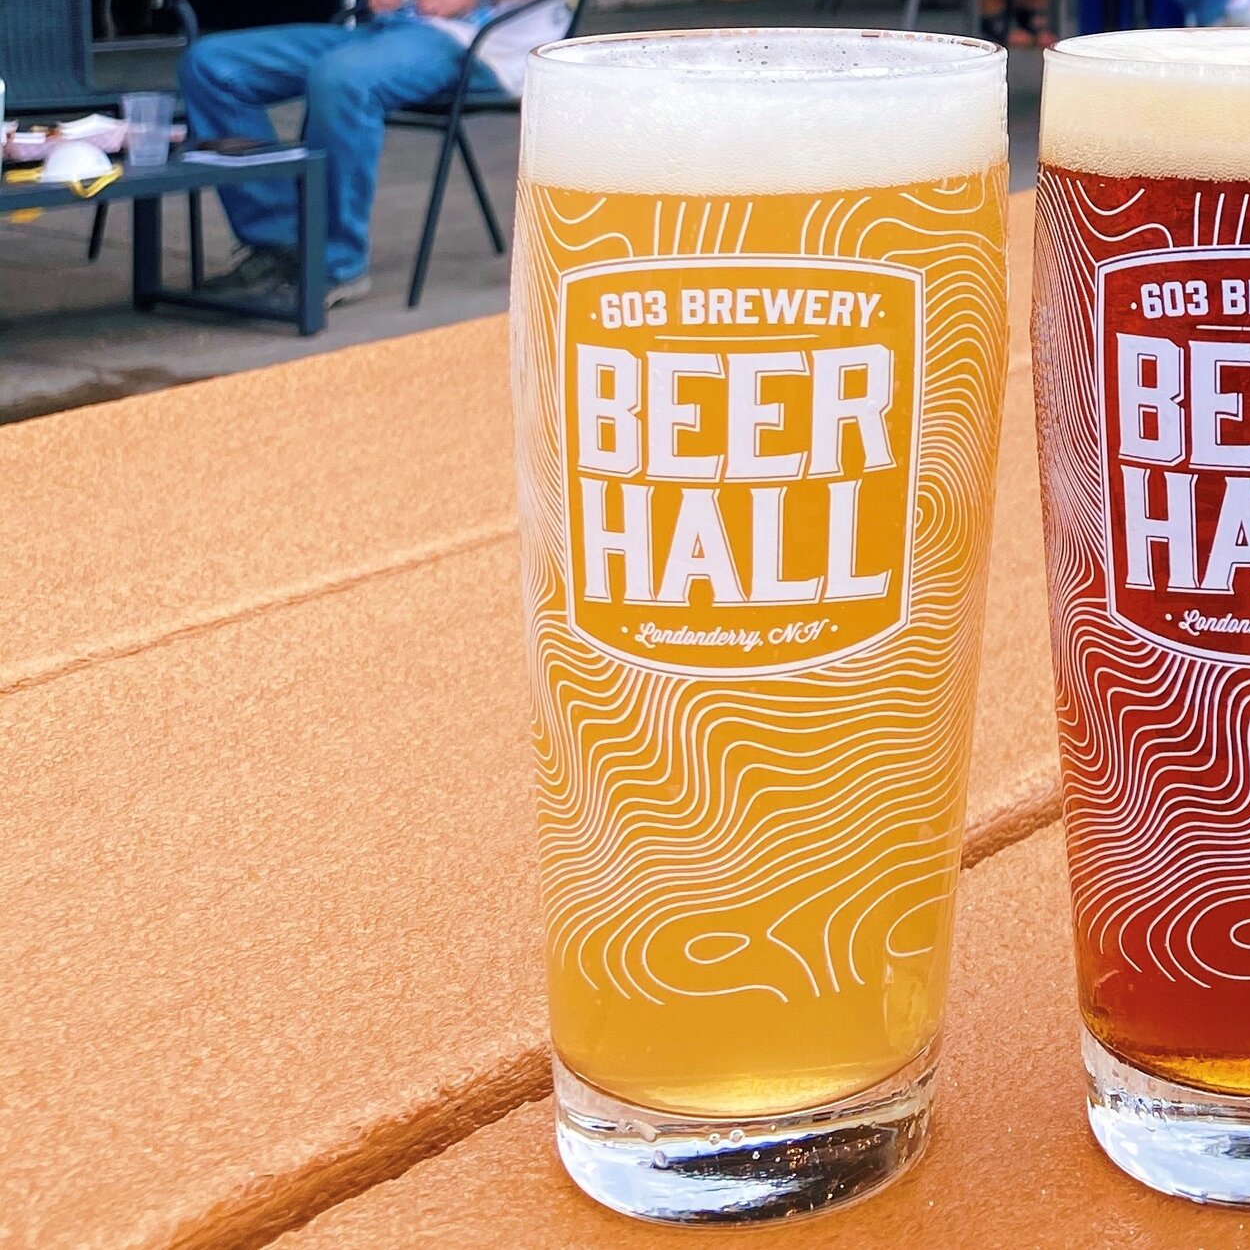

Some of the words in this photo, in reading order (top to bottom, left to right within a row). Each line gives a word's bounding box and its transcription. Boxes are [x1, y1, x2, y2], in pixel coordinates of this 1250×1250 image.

[601, 290, 667, 328] 603
[683, 289, 881, 327] BREWERY
[1141, 281, 1209, 319] 603
[576, 343, 896, 480] BEER
[580, 478, 892, 605] HALL
[635, 622, 764, 652] Londonderry,
[770, 619, 825, 643] NH
